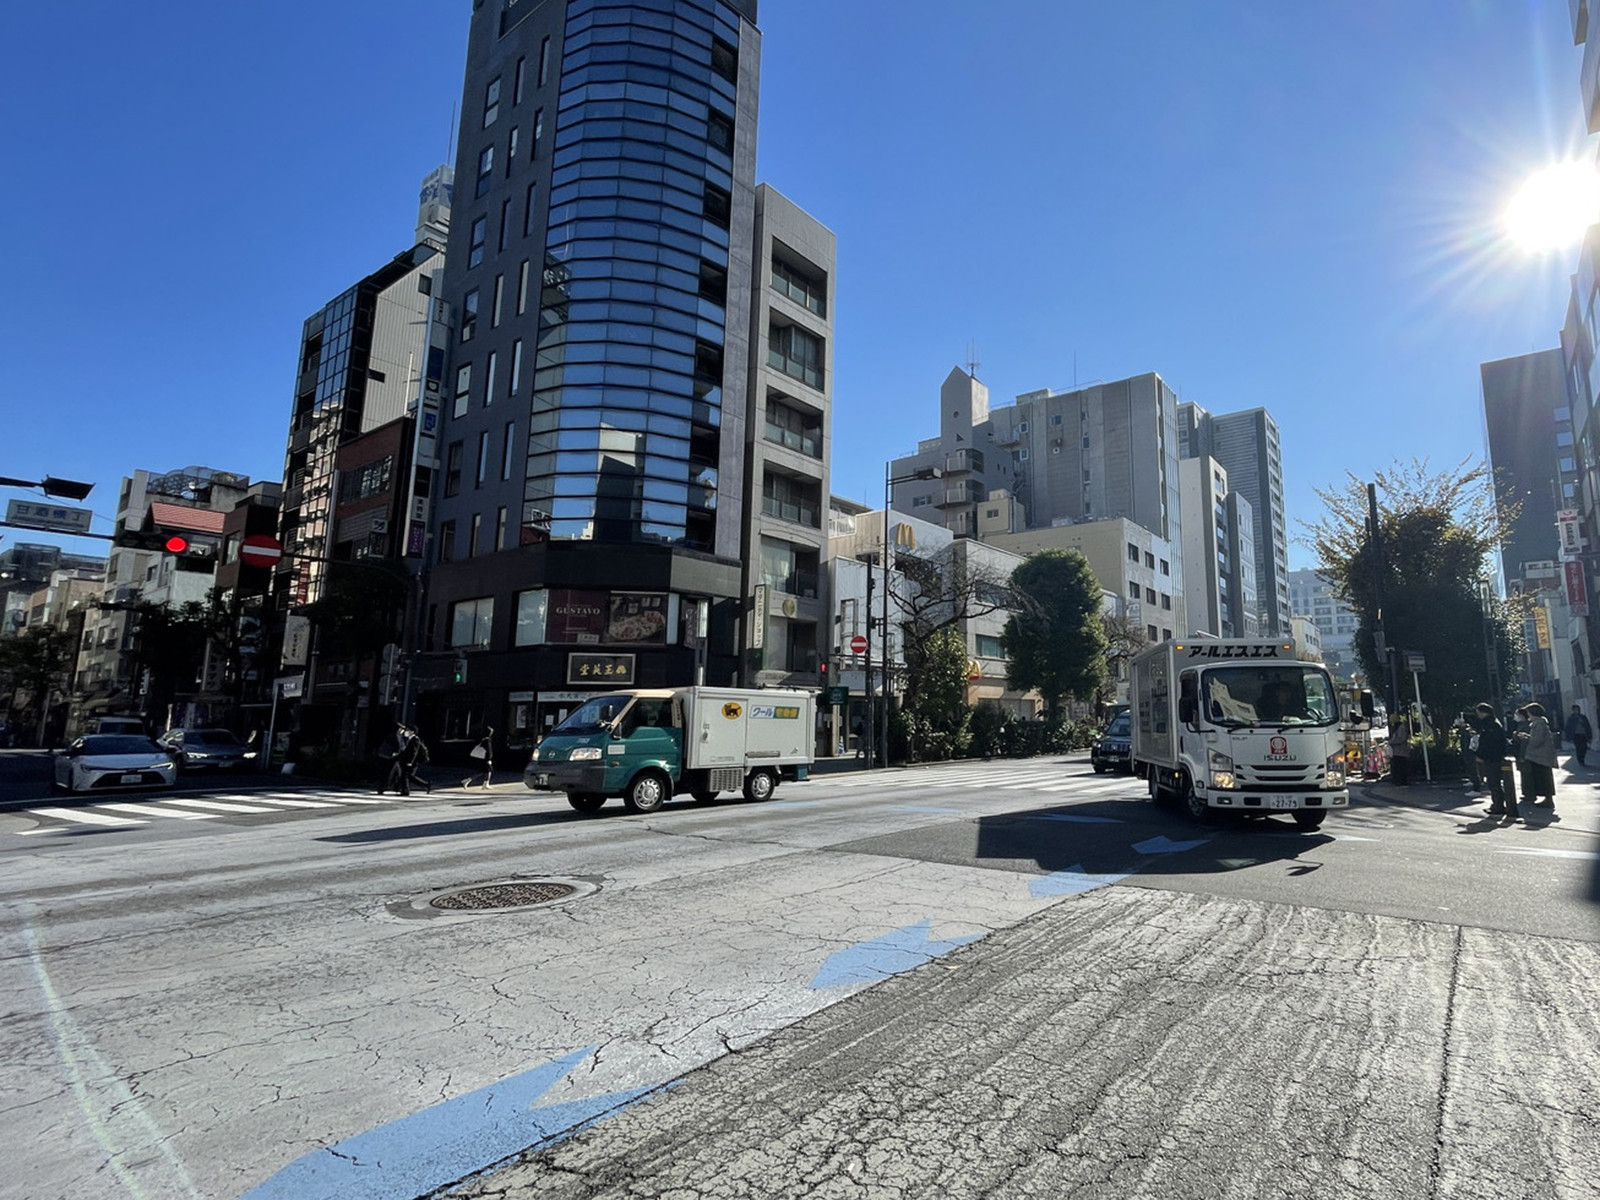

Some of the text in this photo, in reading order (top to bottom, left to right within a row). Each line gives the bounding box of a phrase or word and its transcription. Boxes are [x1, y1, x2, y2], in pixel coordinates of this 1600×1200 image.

[555, 607, 601, 616] GUSTAVO
[1188, 645, 1278, 658] アールエスエス
